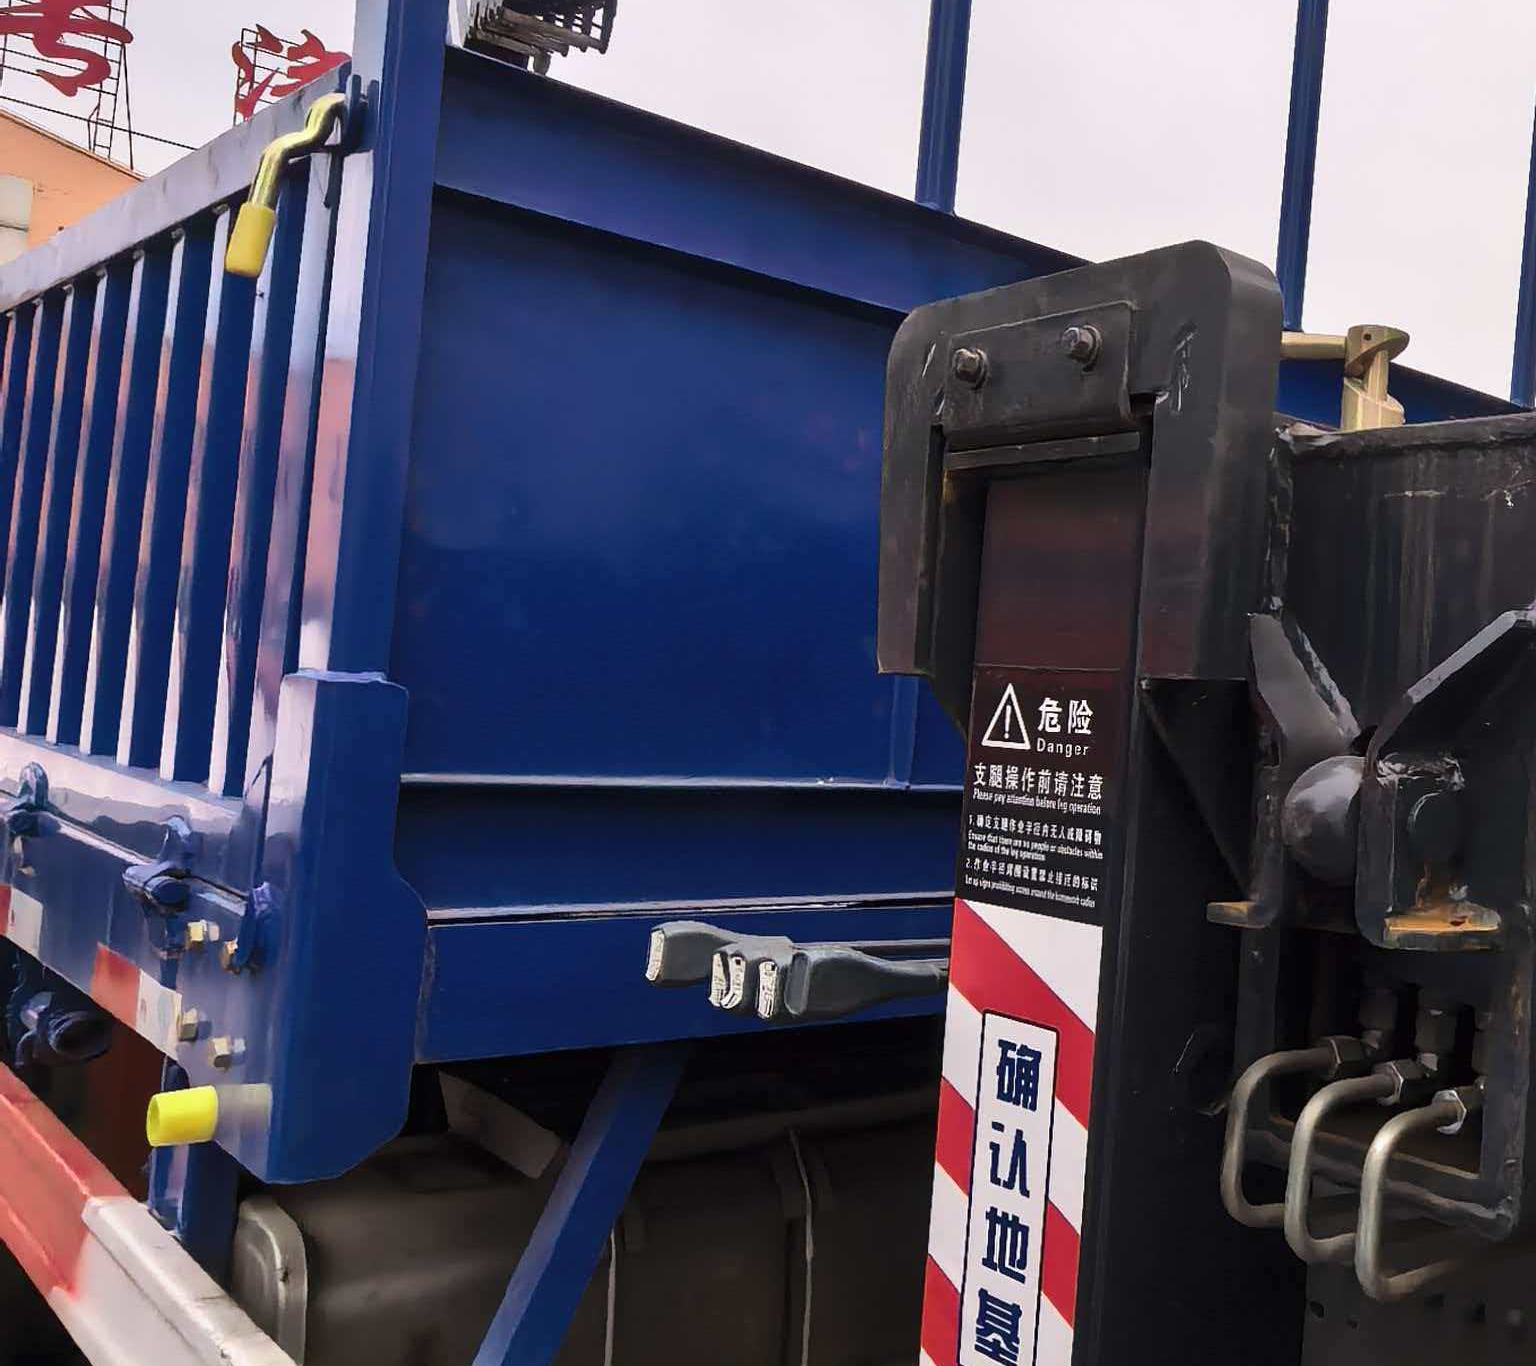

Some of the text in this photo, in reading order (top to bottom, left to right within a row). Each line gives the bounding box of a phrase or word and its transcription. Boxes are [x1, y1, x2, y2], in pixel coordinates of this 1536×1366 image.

[1037, 697, 1095, 735] 危险
[1036, 738, 1089, 757] Danger
[972, 762, 1103, 800] 支腿操作前请注意
